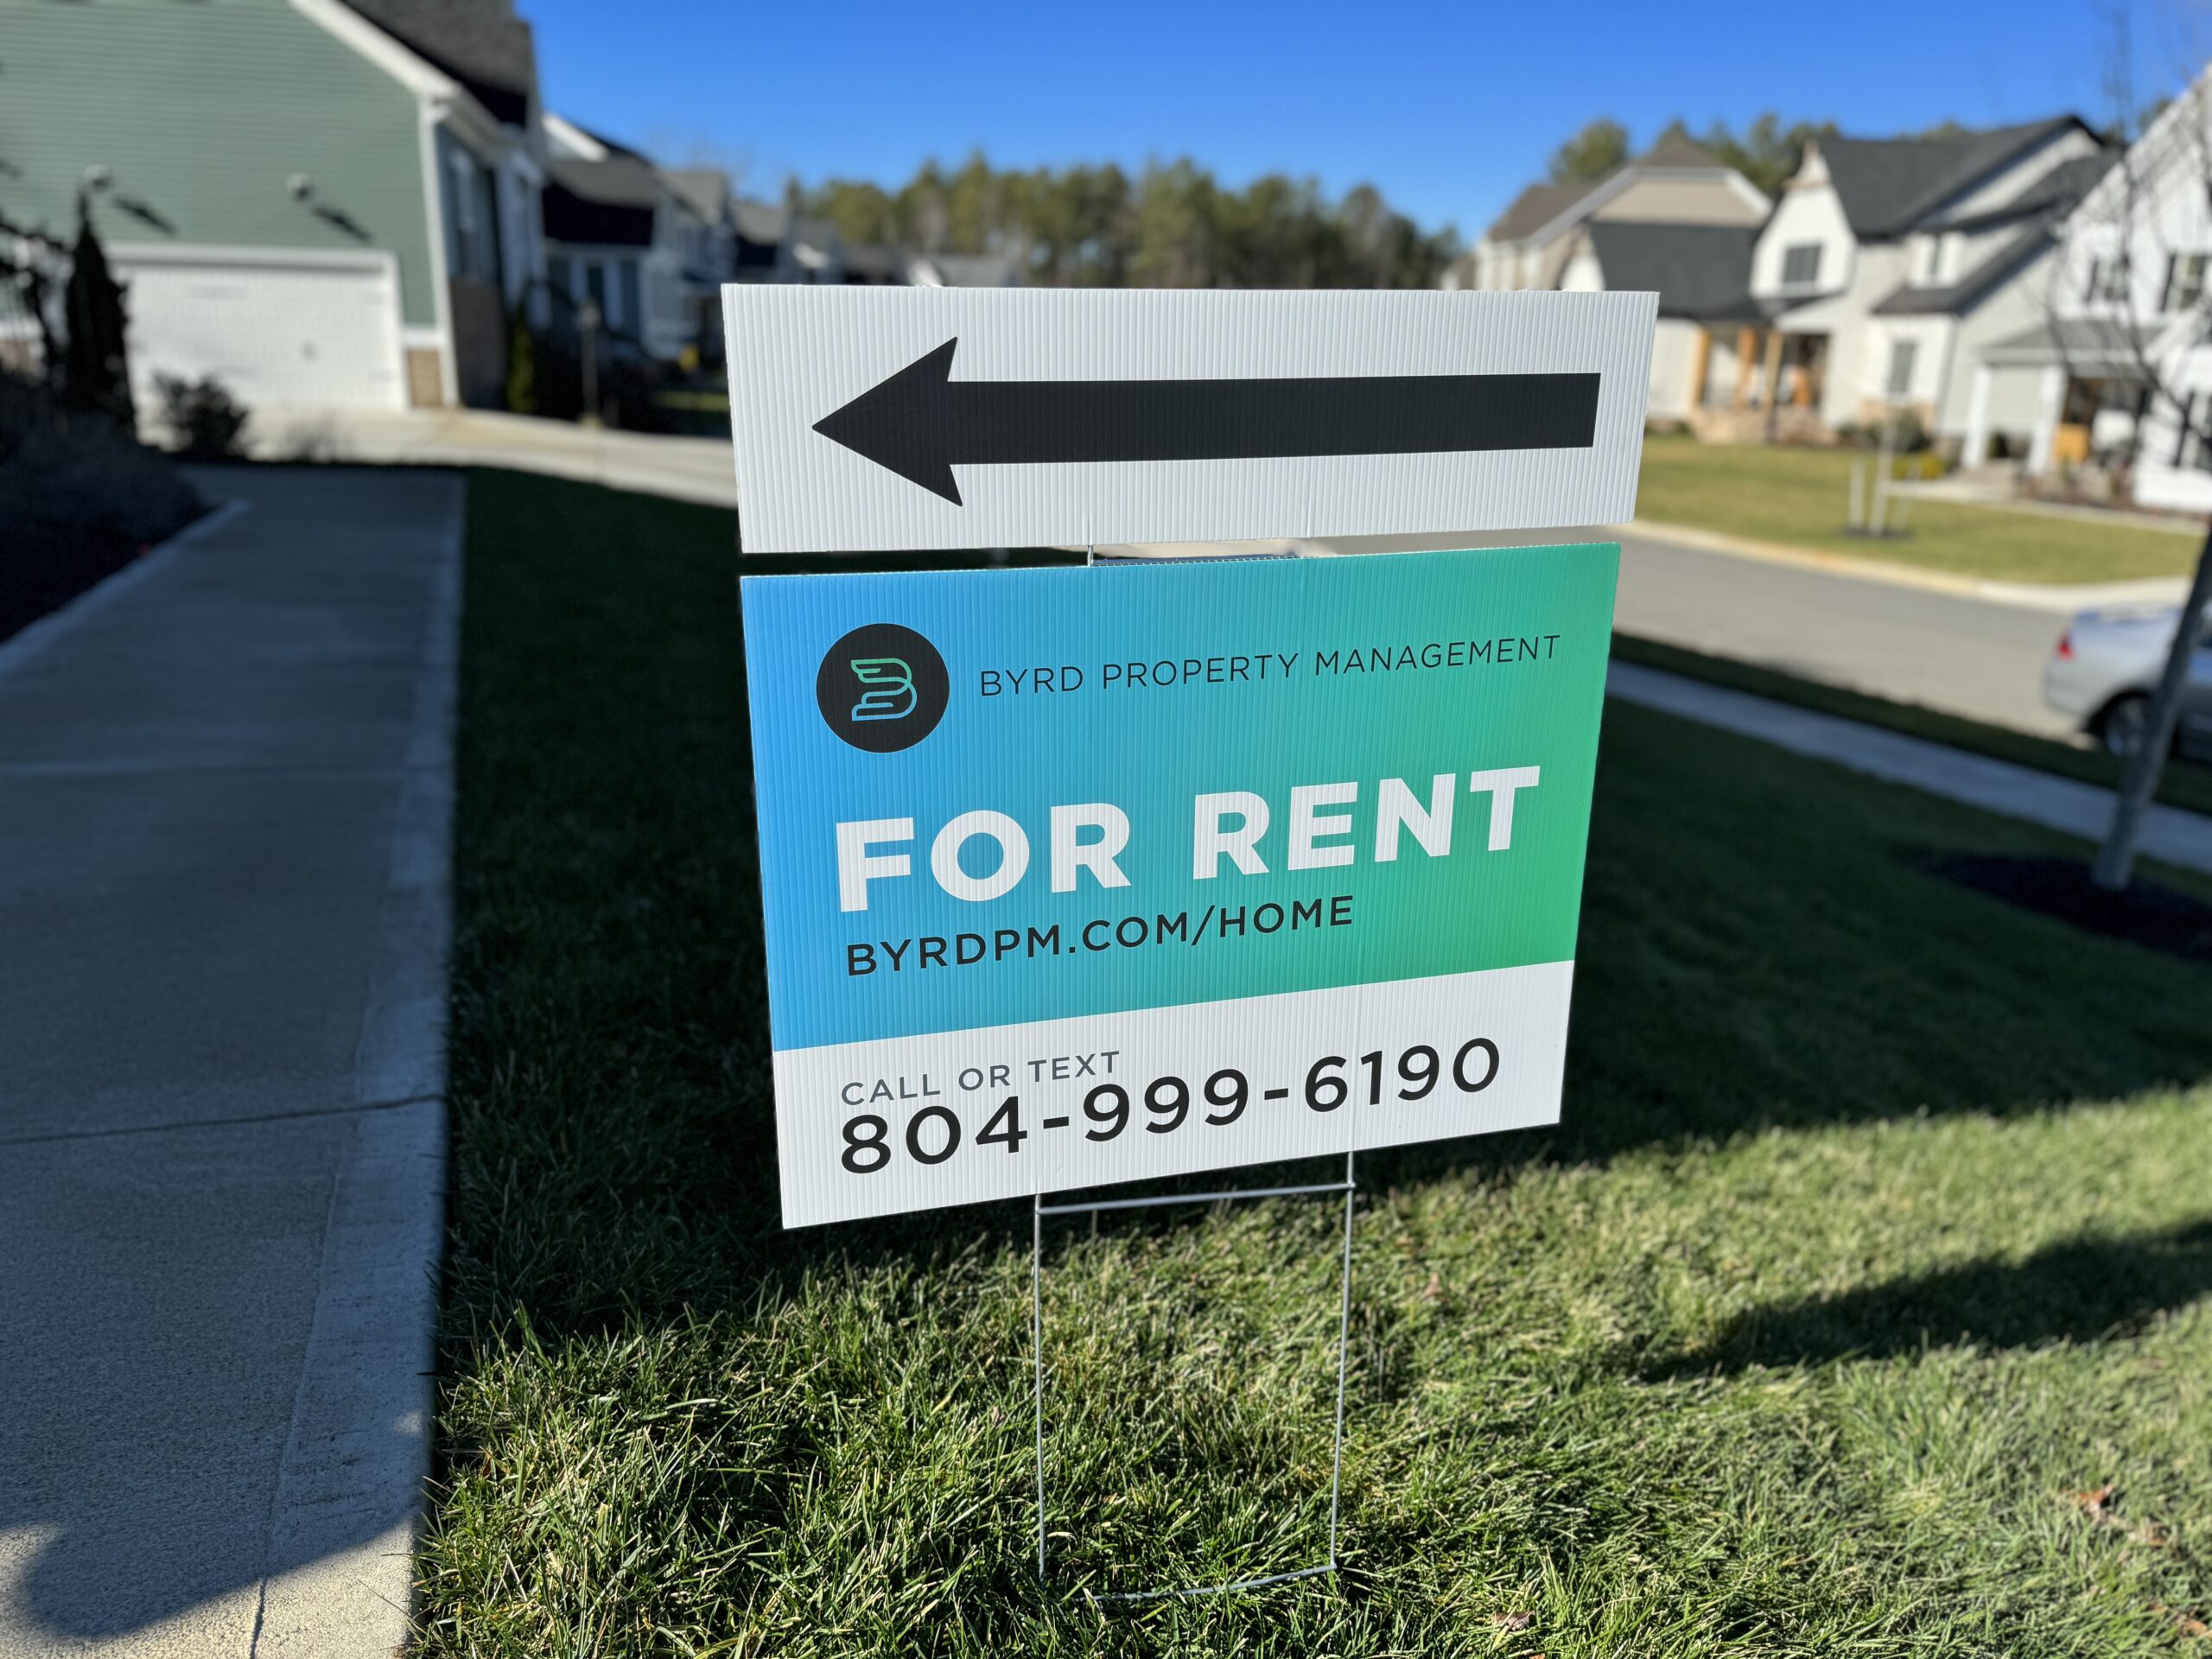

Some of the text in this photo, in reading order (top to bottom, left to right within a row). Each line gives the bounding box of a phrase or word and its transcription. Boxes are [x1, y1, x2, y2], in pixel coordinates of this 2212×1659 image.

[981, 634, 1561, 696] BYRD PROPERTY MANAGEMENT
[835, 766, 1541, 912] FOR RENT
[847, 894, 1354, 976] BYRDPM.COM/HOME
[841, 1050, 1121, 1107] CALL OR TEXT
[841, 1037, 1501, 1174] 804-999-6190
